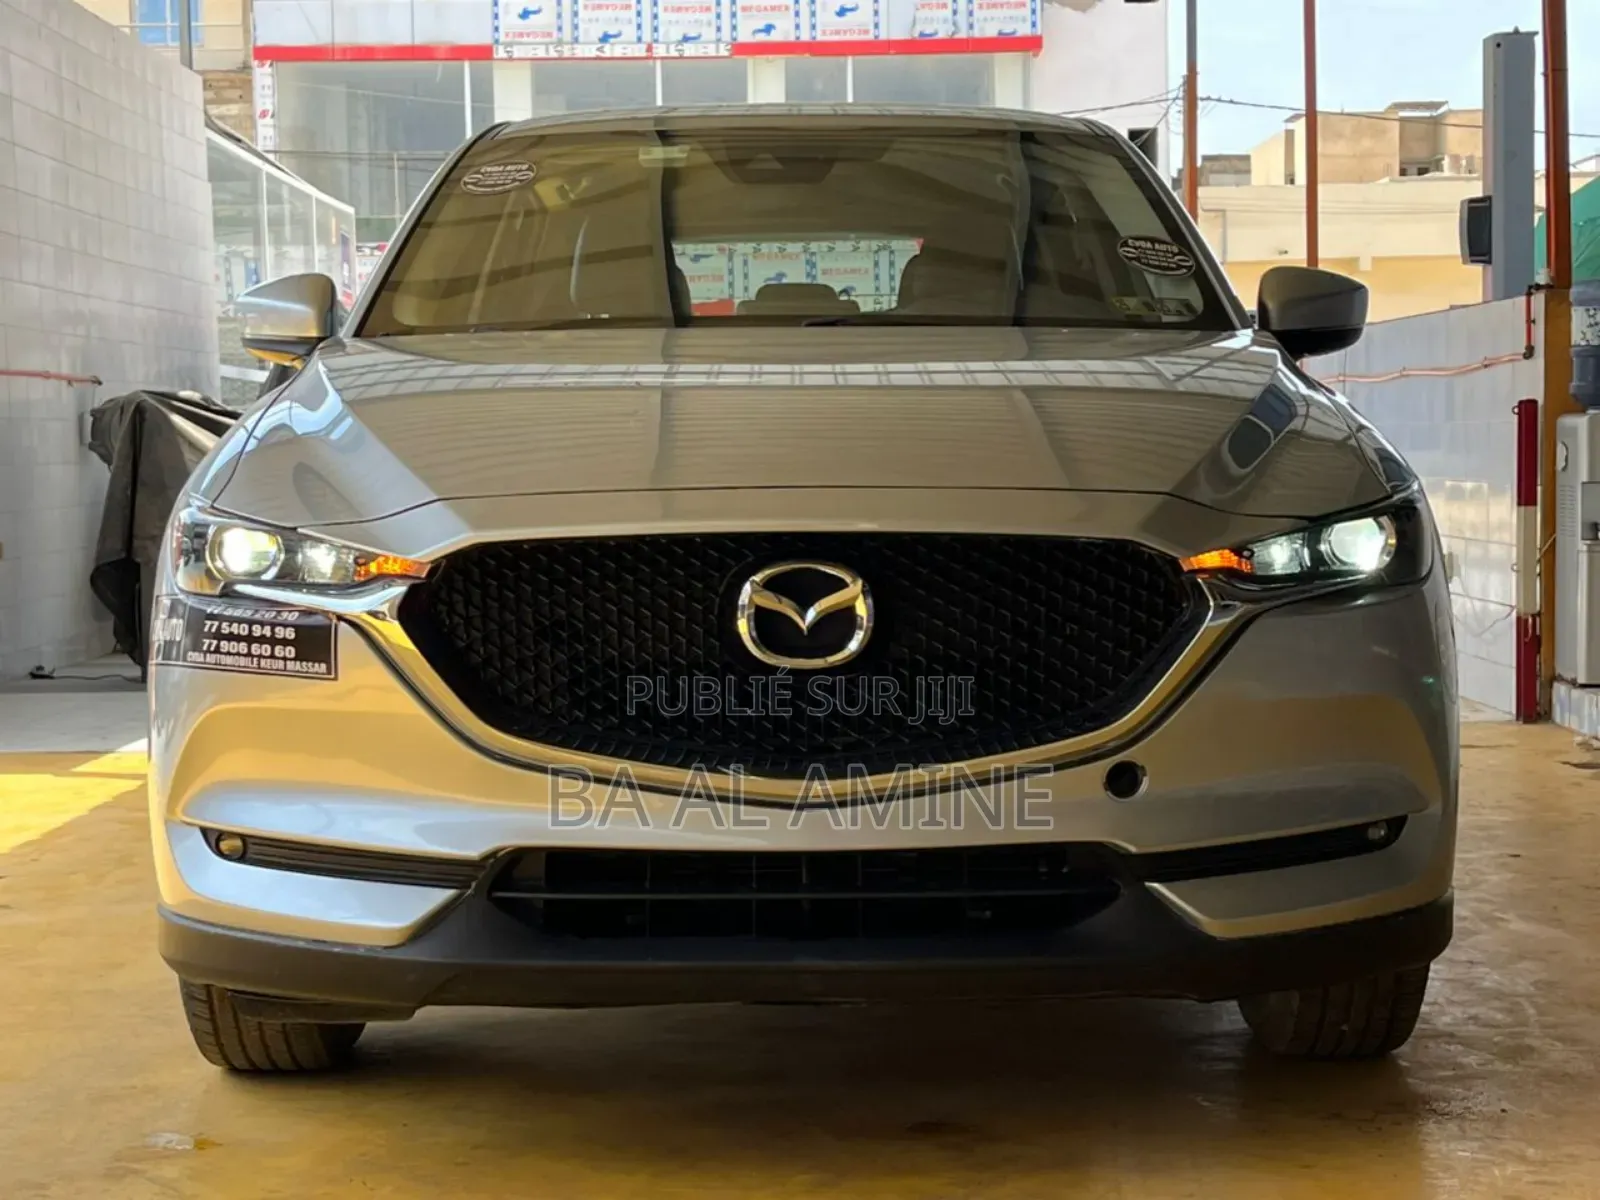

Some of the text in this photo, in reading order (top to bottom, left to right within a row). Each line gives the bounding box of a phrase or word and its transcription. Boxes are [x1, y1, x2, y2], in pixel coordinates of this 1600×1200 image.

[204, 620, 296, 640] 77 540 94 96
[202, 639, 296, 659] 77 906 60 60
[205, 652, 259, 668] AUTOMOBILE
[260, 657, 285, 671] KEUR
[286, 660, 327, 674] MASSAR
